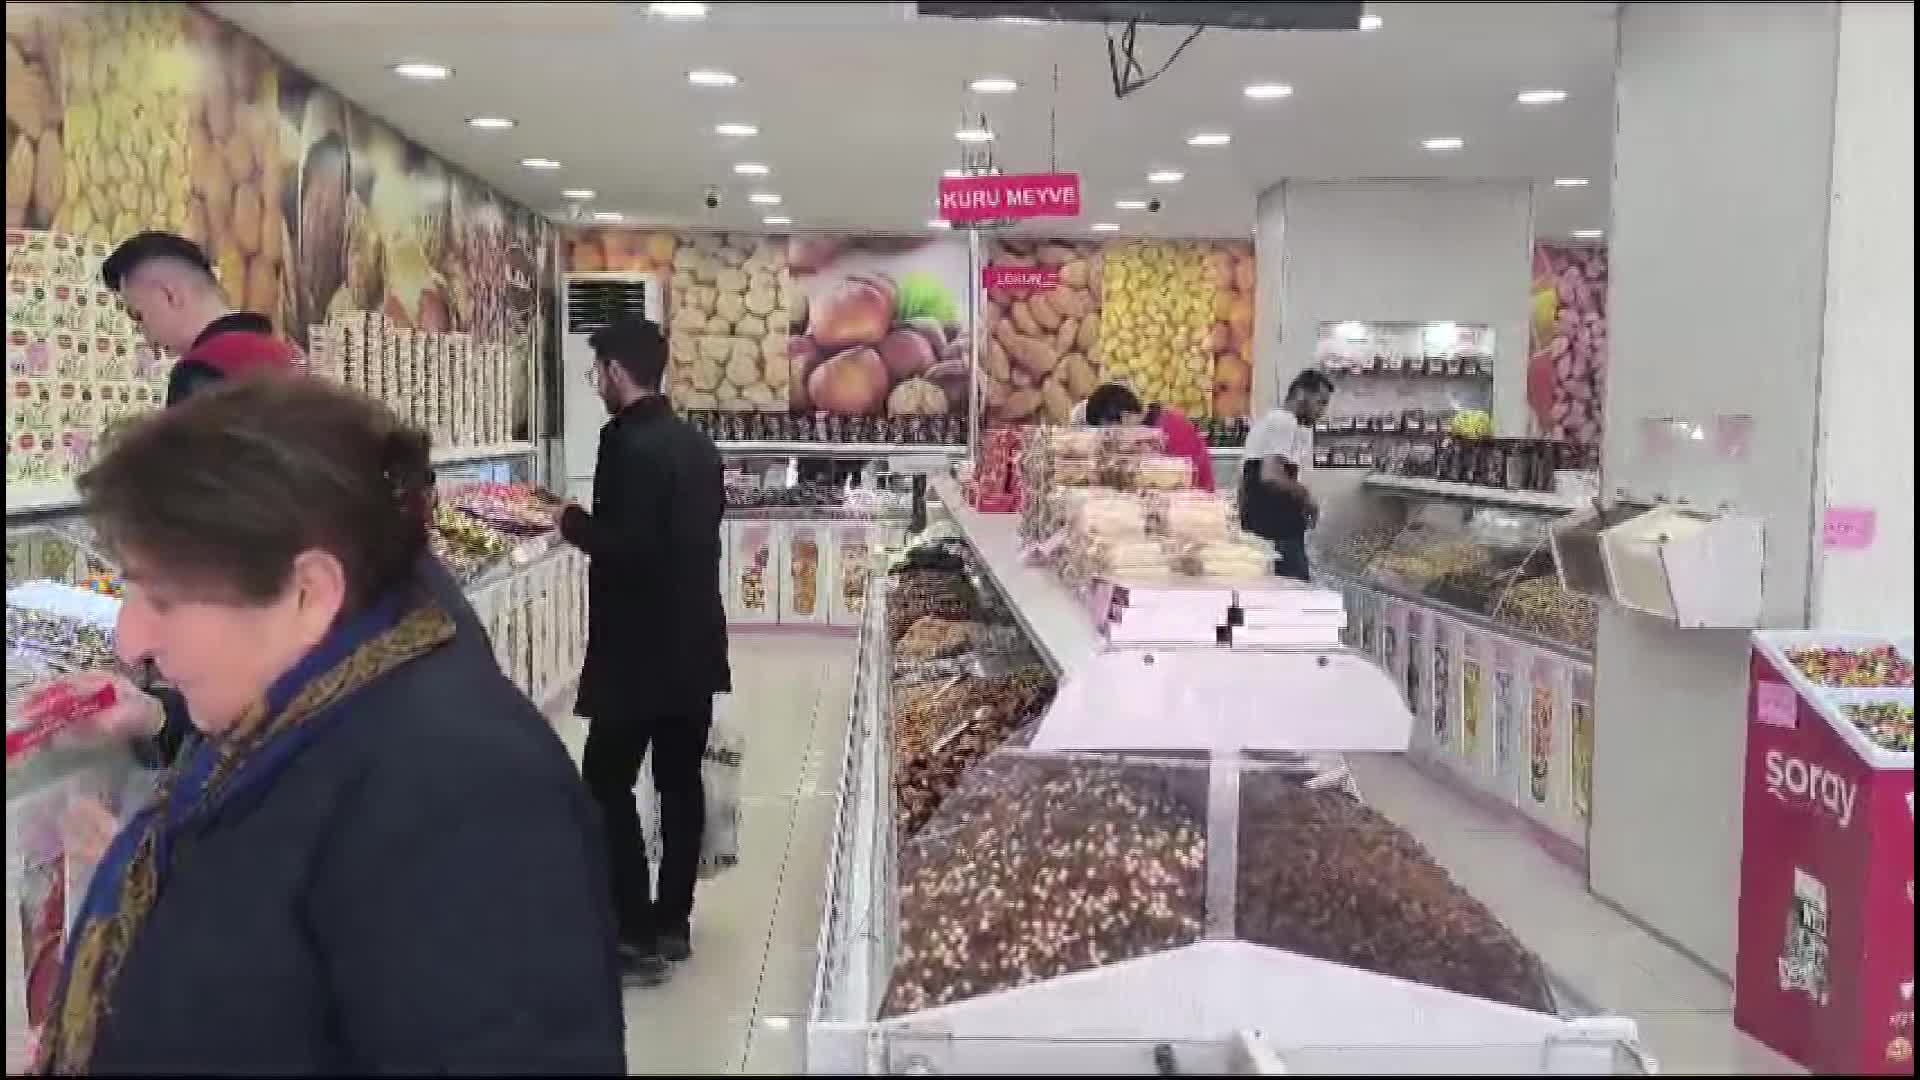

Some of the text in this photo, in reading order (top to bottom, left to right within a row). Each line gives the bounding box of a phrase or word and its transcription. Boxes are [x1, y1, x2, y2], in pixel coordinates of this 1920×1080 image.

[943, 186, 1077, 209] KURU MEYVE
[1765, 749, 1858, 827] soray
